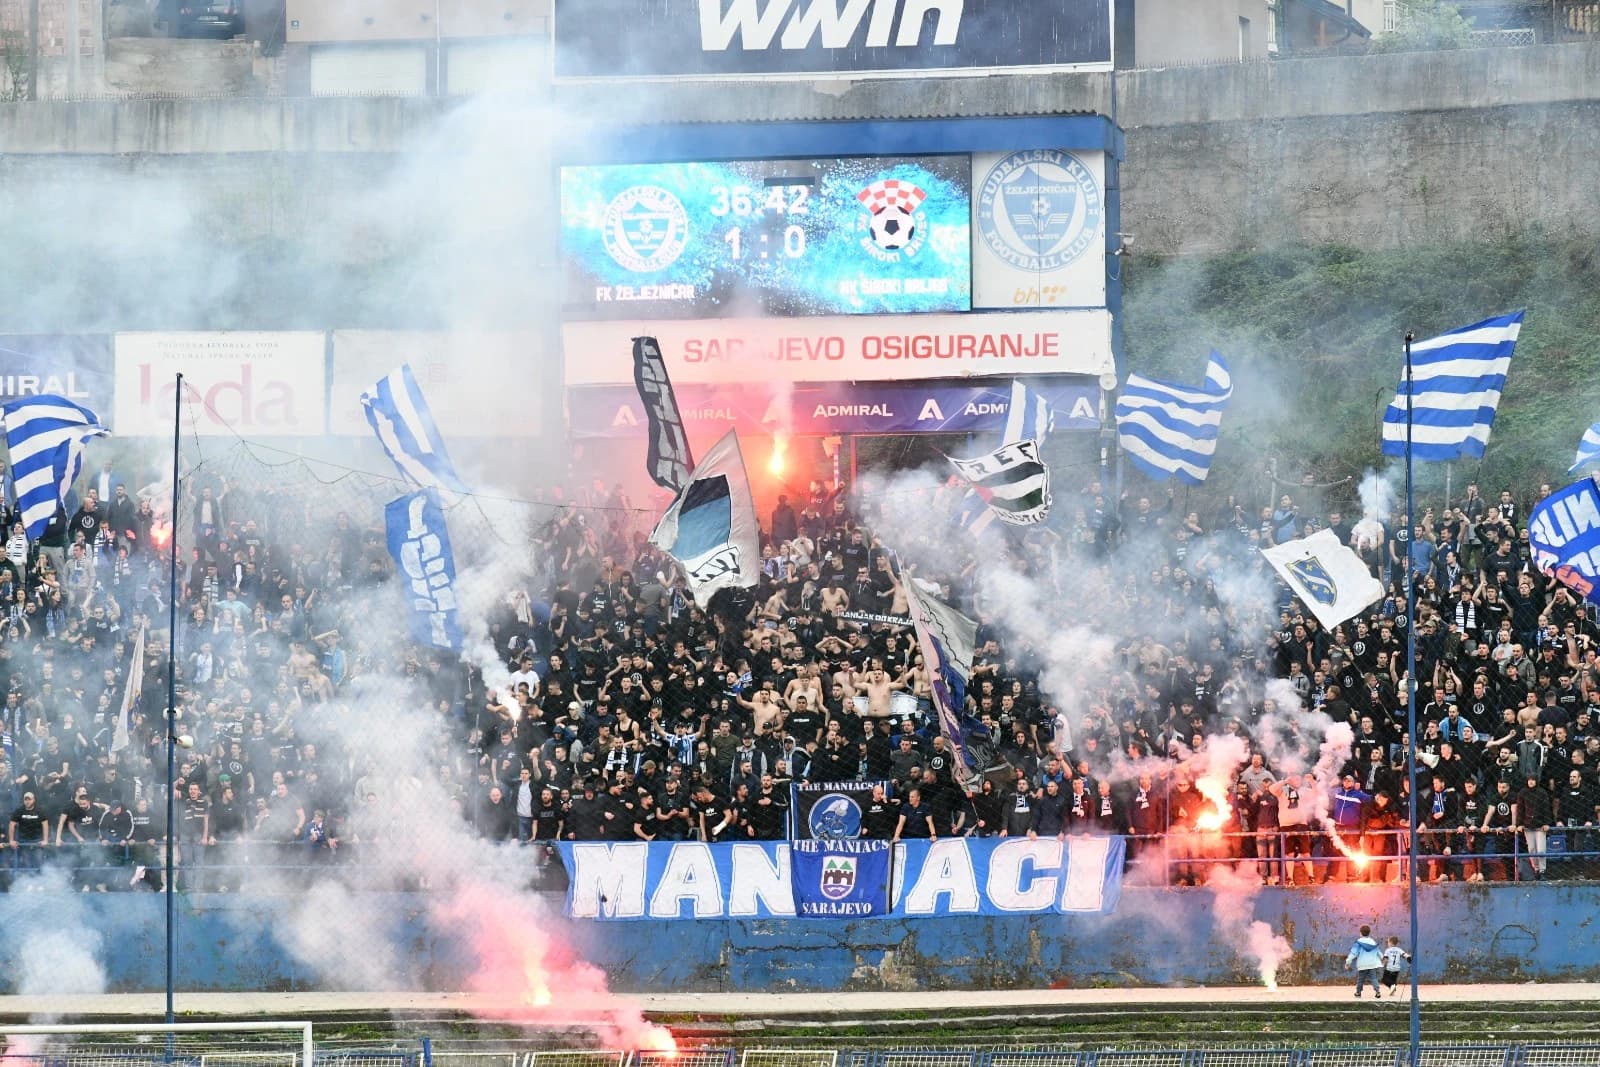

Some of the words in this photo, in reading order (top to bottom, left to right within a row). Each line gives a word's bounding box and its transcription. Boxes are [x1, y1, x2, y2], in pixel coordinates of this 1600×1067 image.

[709, 185, 811, 217] 36:42
[986, 229, 1059, 270] FOOTBALL
[1061, 228, 1095, 262] CLUB
[684, 336, 845, 363] SARJEVO
[862, 333, 1059, 360] OSIGURANJE
[0, 372, 89, 398] IRAL
[138, 363, 300, 427] leda
[681, 407, 737, 420] MIRAL
[812, 403, 894, 418] ADMIRAL
[823, 782, 875, 792] MANIACS
[792, 839, 819, 853] THE
[824, 839, 890, 854] MANIACS
[572, 836, 1109, 918] MANACI
[802, 902, 873, 915] SARAJEVO
